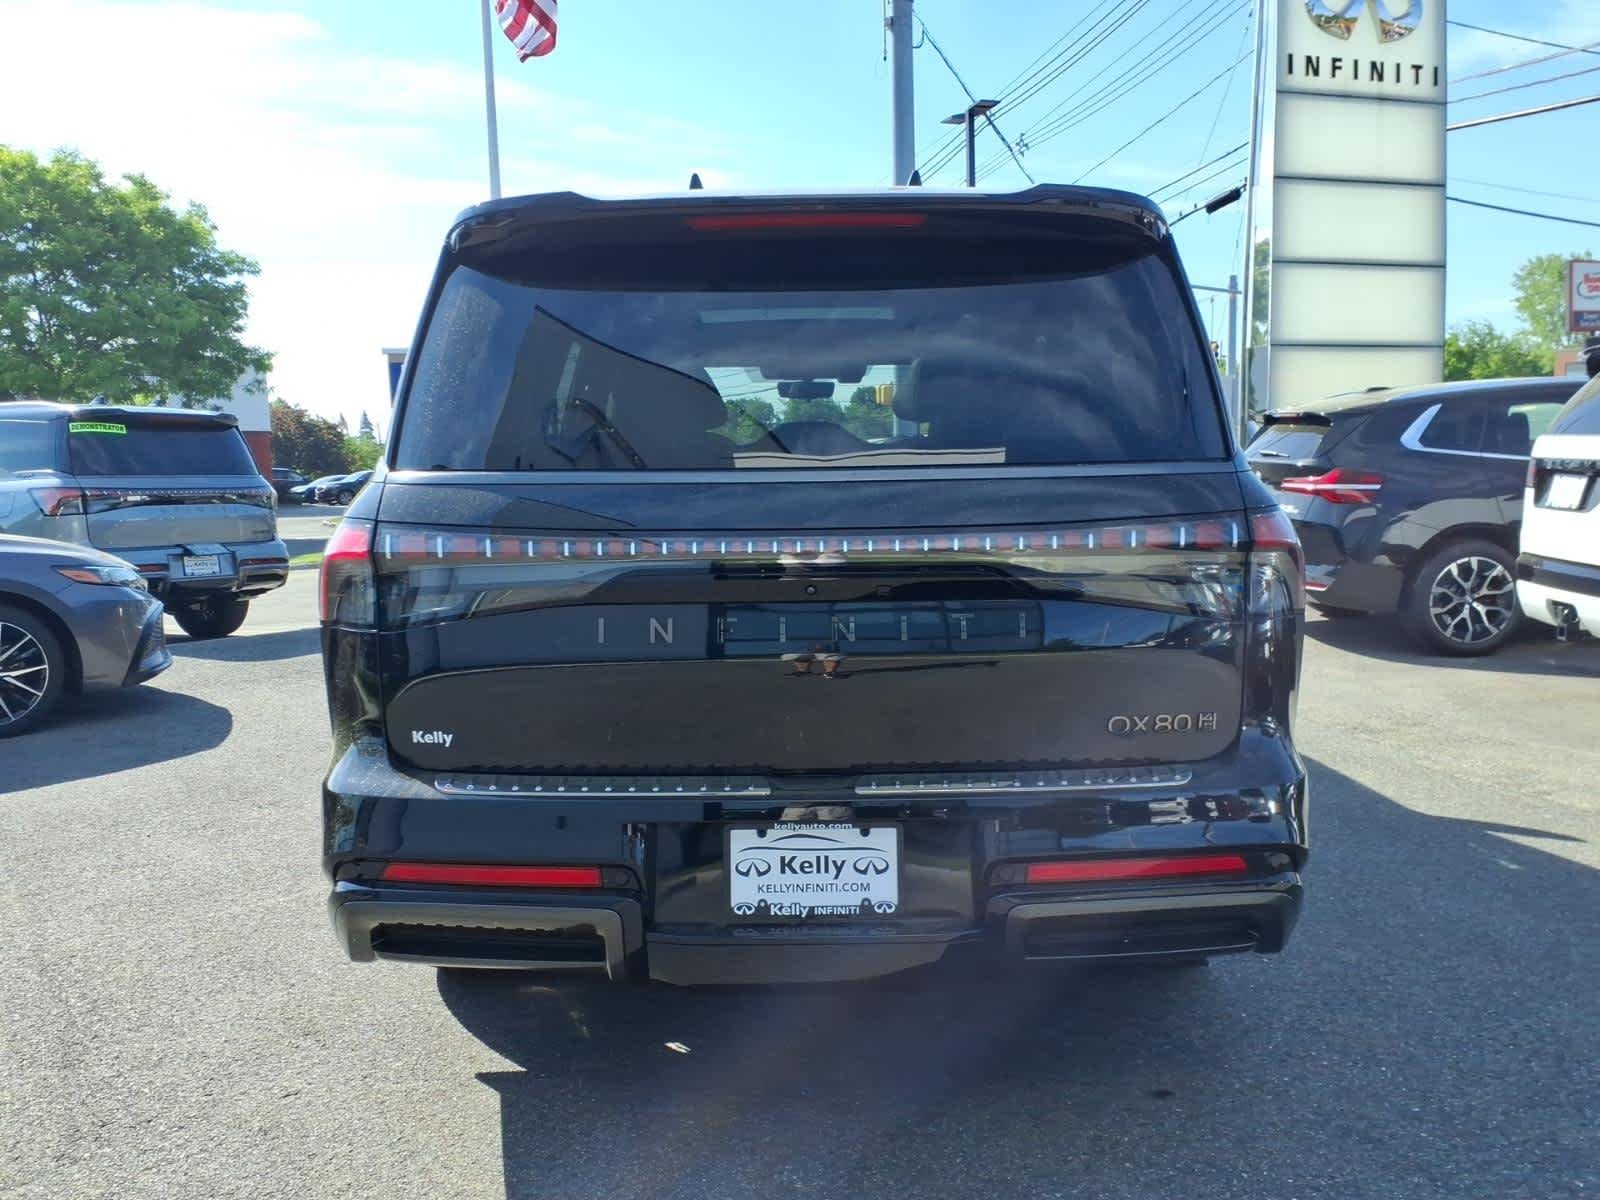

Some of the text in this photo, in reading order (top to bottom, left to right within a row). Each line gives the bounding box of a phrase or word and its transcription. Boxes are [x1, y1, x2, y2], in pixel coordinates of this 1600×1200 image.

[1287, 53, 1439, 87] INFINITI
[597, 611, 1026, 644] INFINITI
[411, 730, 454, 748] Kelly
[774, 822, 853, 831] kellyauto.com
[780, 855, 846, 880] Kelly
[757, 882, 871, 894] KELLYINFINITI.COM
[770, 903, 860, 918] Kelly INFINITI
